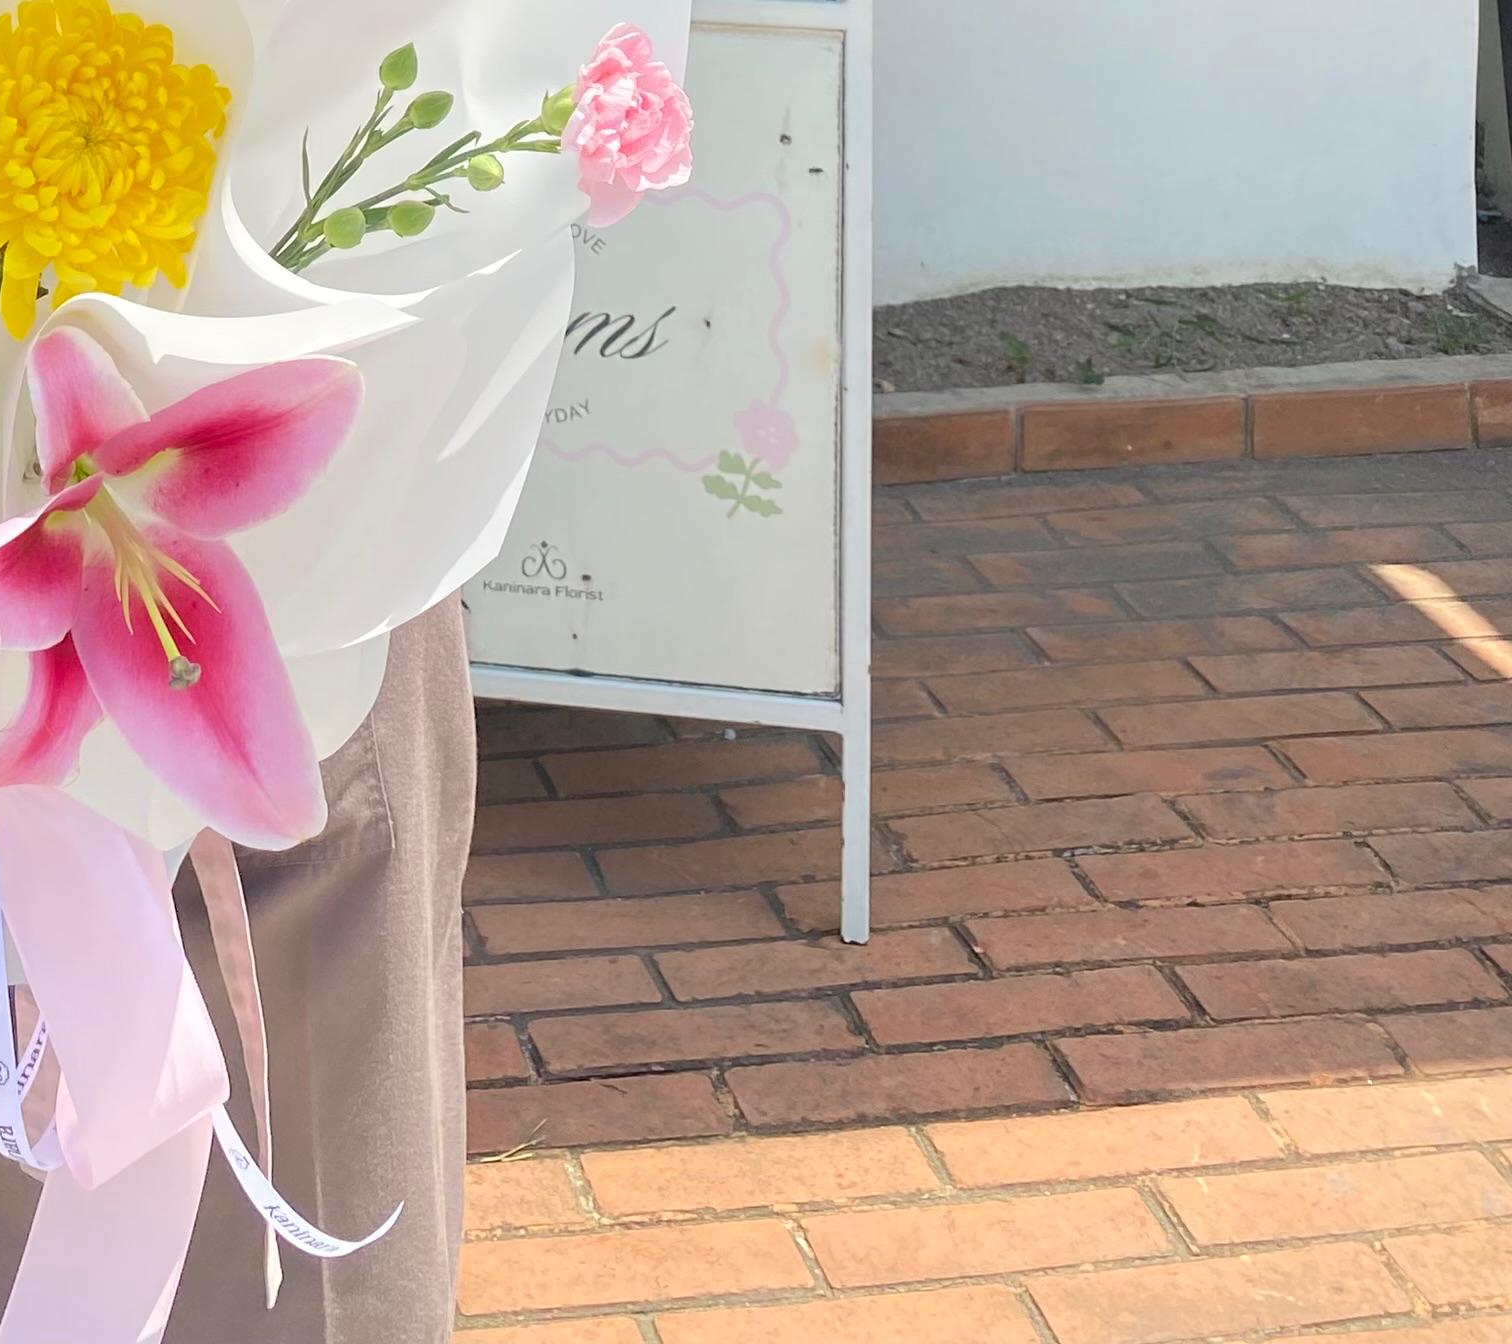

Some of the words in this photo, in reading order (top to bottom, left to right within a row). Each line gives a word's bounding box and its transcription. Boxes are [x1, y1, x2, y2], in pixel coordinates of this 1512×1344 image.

[570, 223, 606, 255] OVE
[483, 580, 551, 596] Kaninara
[555, 586, 603, 600] Florist
